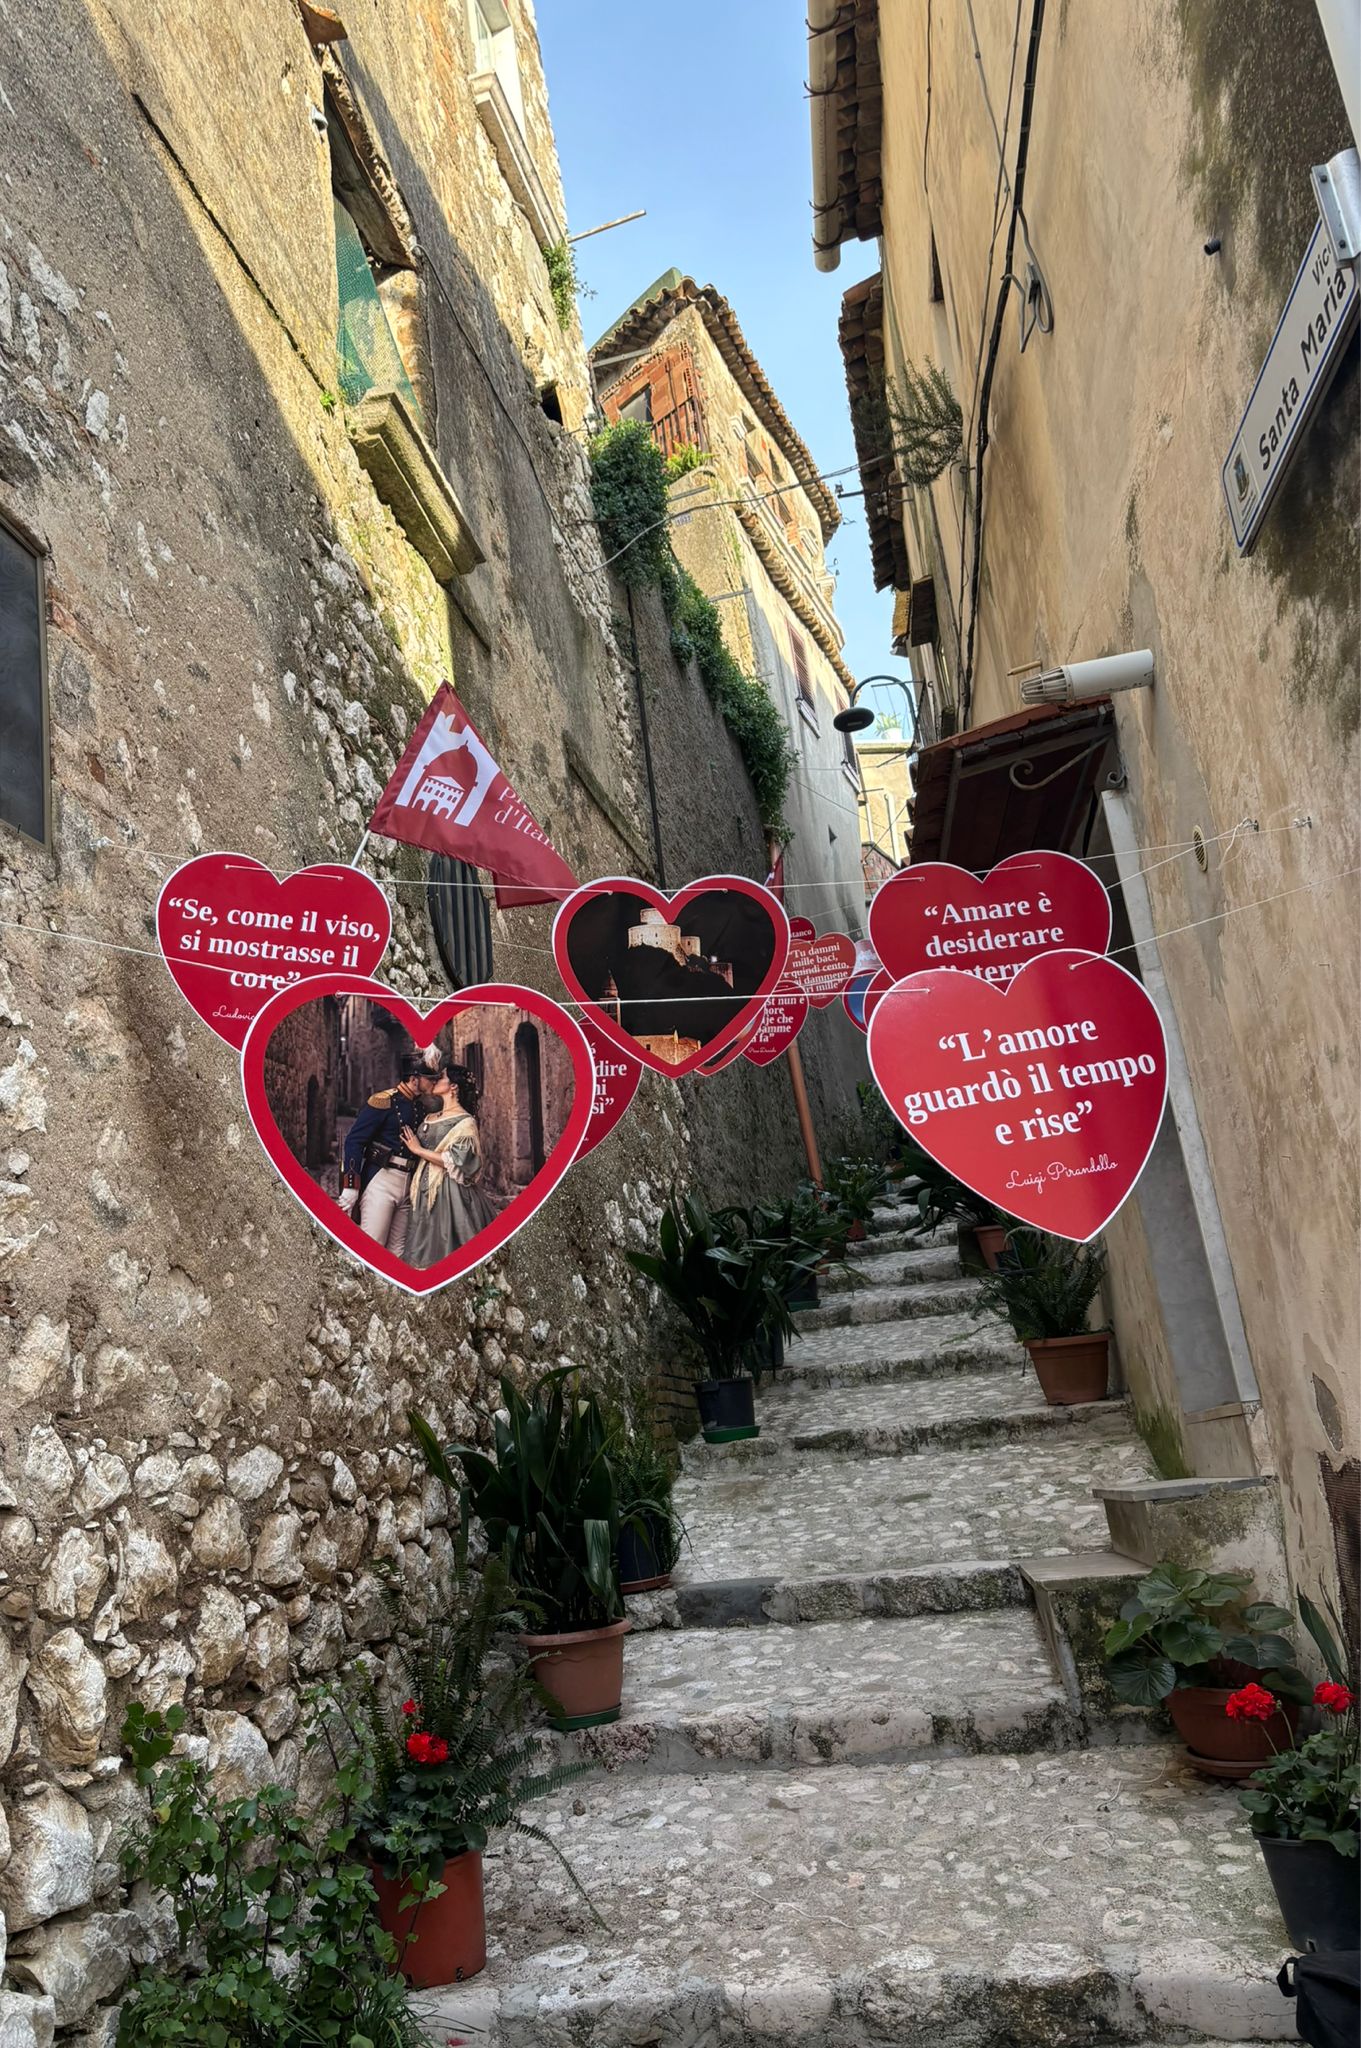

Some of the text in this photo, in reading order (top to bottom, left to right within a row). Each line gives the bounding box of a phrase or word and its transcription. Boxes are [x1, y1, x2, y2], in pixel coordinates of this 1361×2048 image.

[1312, 244, 1331, 286] Vic
[1259, 268, 1347, 471] Santa Maria
[168, 897, 381, 943] “Se, come il viso,
[924, 892, 1052, 925] “Amare è
[180, 930, 359, 967] si mostrasse il
[808, 942, 840, 955] dammi
[925, 925, 1065, 957] desiderare
[791, 965, 820, 978] quindi
[822, 962, 849, 972] cento,
[792, 953, 838, 968] mille baci,
[804, 971, 848, 984] dammene
[230, 971, 301, 991] core”
[777, 1014, 793, 1023] che
[938, 1019, 1099, 1062] “L’amore
[904, 1053, 1156, 1125] guardò il tempo
[994, 1100, 1093, 1145] e rise”
[1005, 1153, 1119, 1194] Luigi Pirandello
